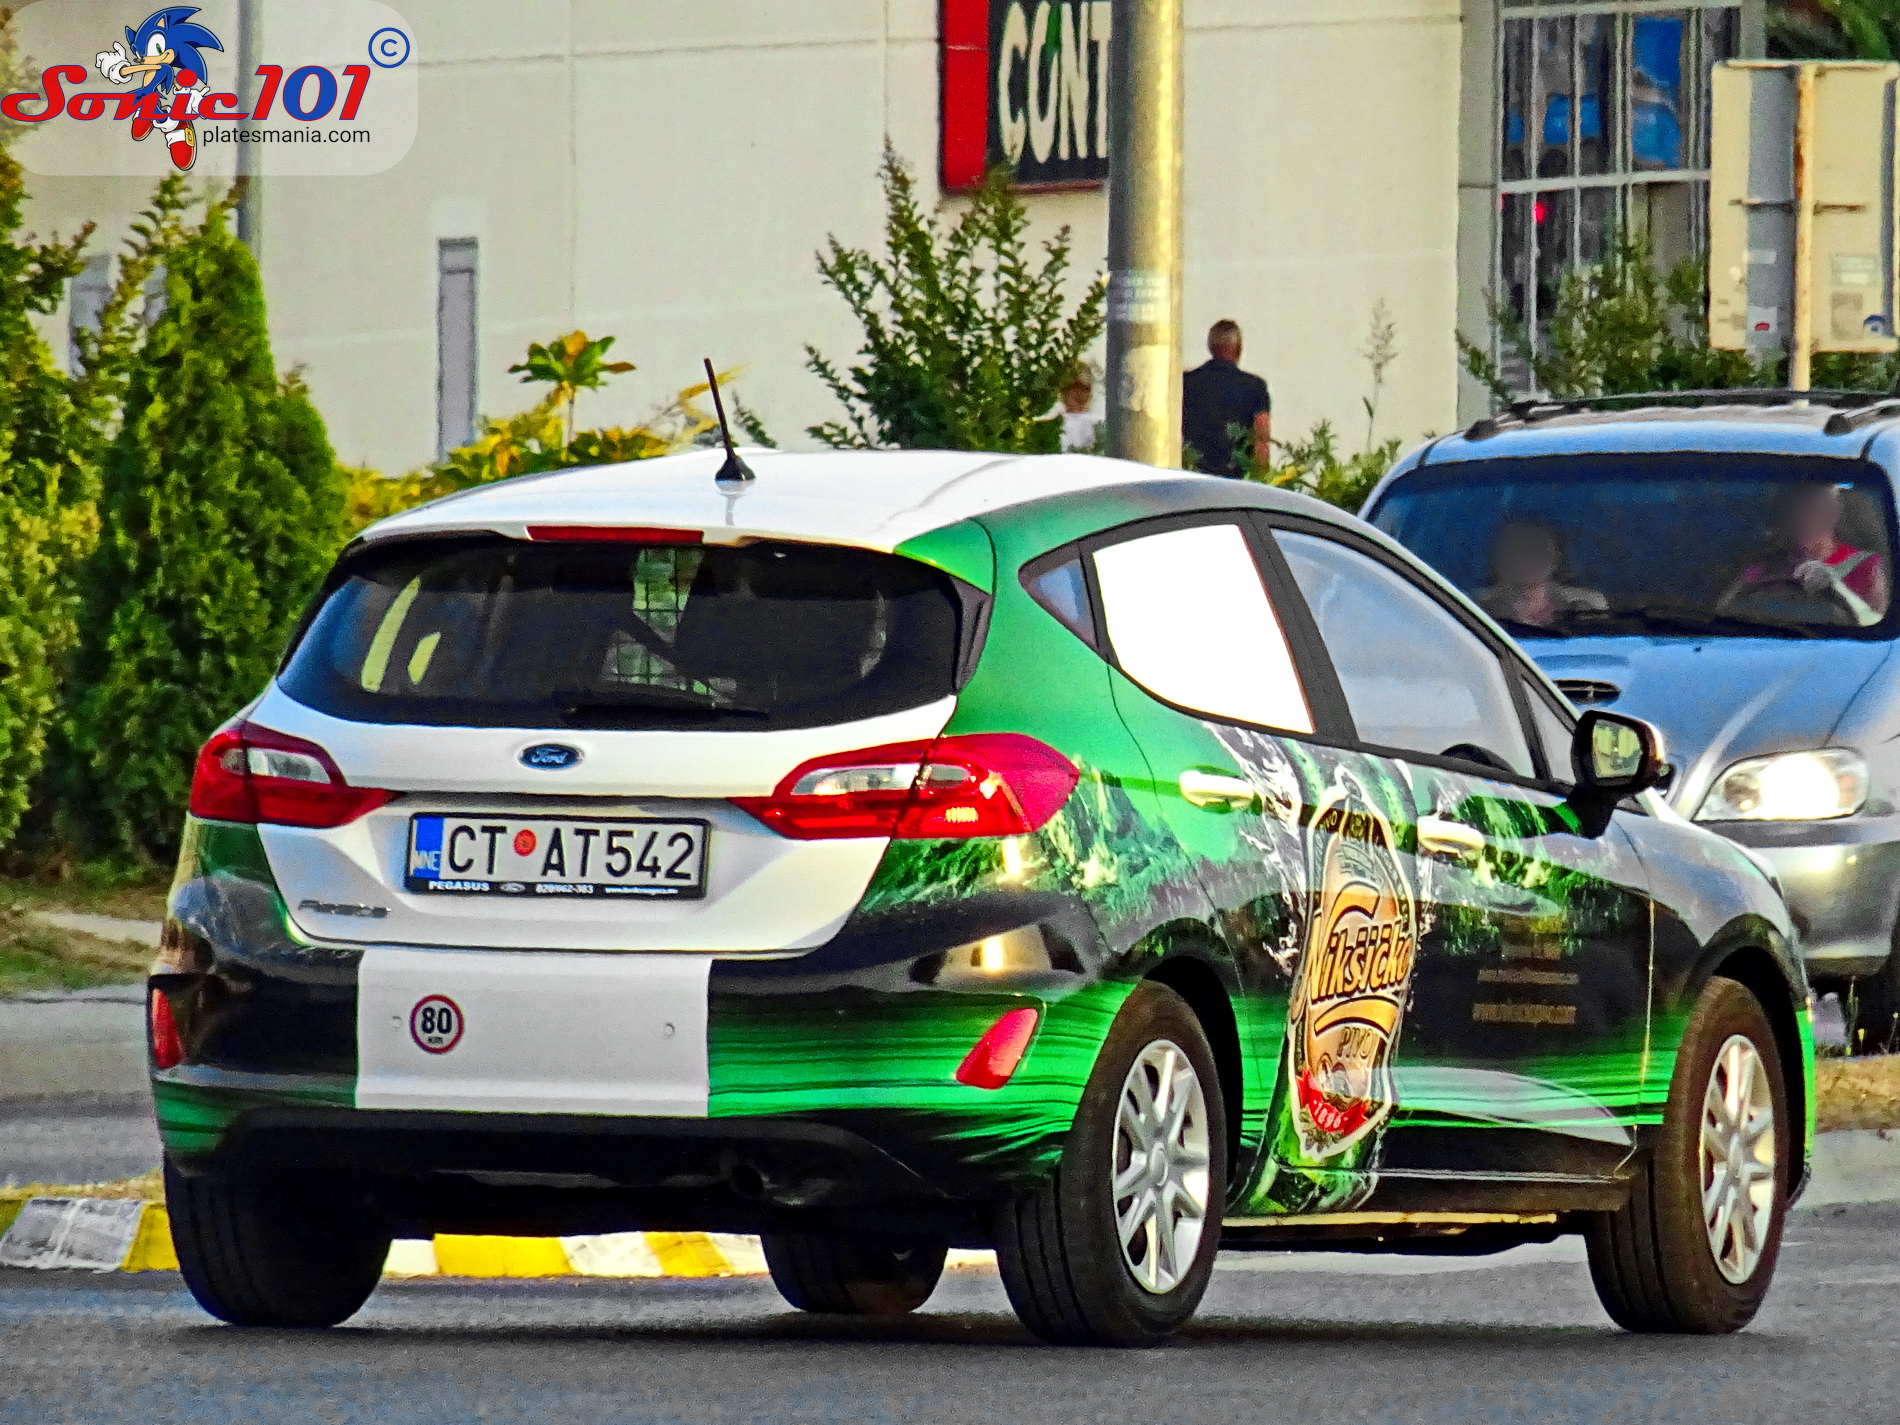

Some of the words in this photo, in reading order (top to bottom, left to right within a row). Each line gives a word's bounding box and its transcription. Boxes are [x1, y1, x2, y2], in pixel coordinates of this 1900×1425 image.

[448, 824, 508, 876] CT
[541, 827, 695, 881] AT542
[428, 880, 490, 892] PEGASUS
[421, 1006, 453, 1035] 80
